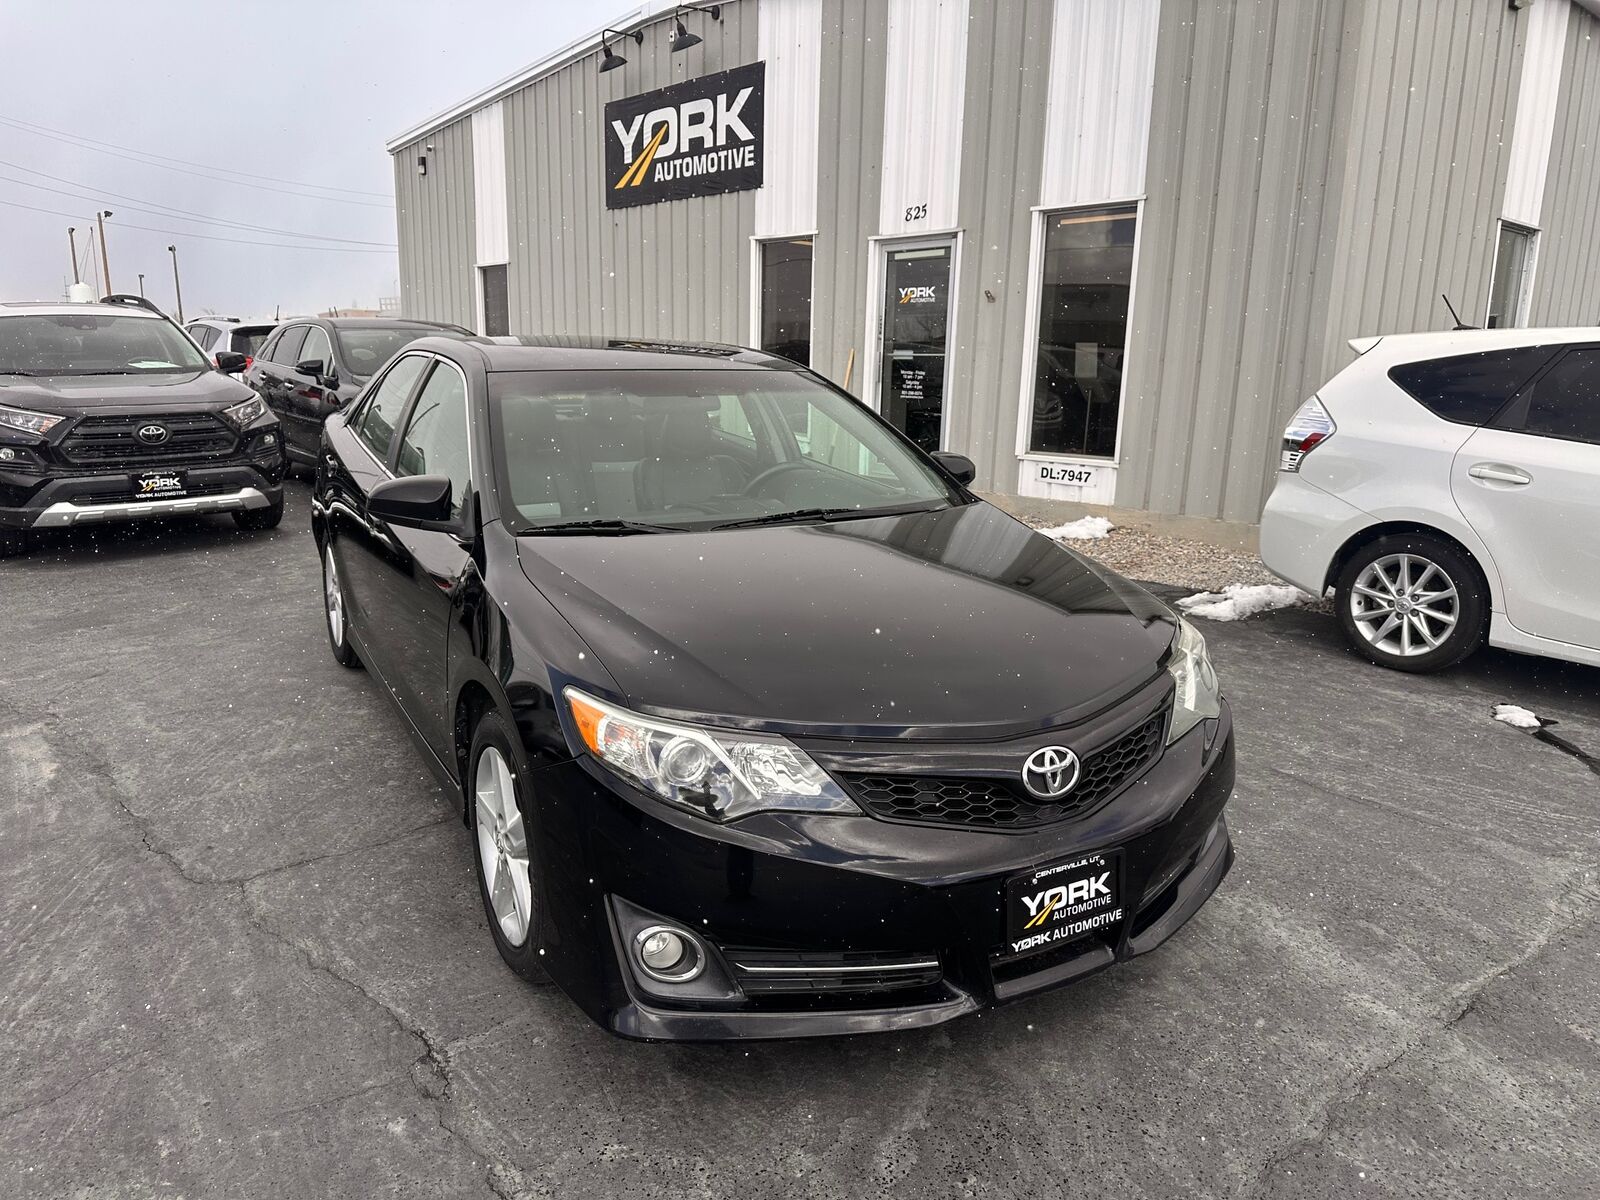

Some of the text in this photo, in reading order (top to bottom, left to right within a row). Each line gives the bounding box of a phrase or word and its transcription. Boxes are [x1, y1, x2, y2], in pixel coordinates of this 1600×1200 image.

[611, 86, 755, 164] YORK
[654, 145, 755, 183] AUTOMOTIVE
[905, 203, 927, 222] 825
[898, 286, 936, 298] YORK
[138, 478, 180, 488] YORK
[1040, 466, 1092, 483] DL:7947
[1021, 871, 1111, 917] YORK
[1053, 894, 1112, 921] AUTOMOTIVE
[1011, 908, 1122, 953] YORK AUTOMOTIVE
